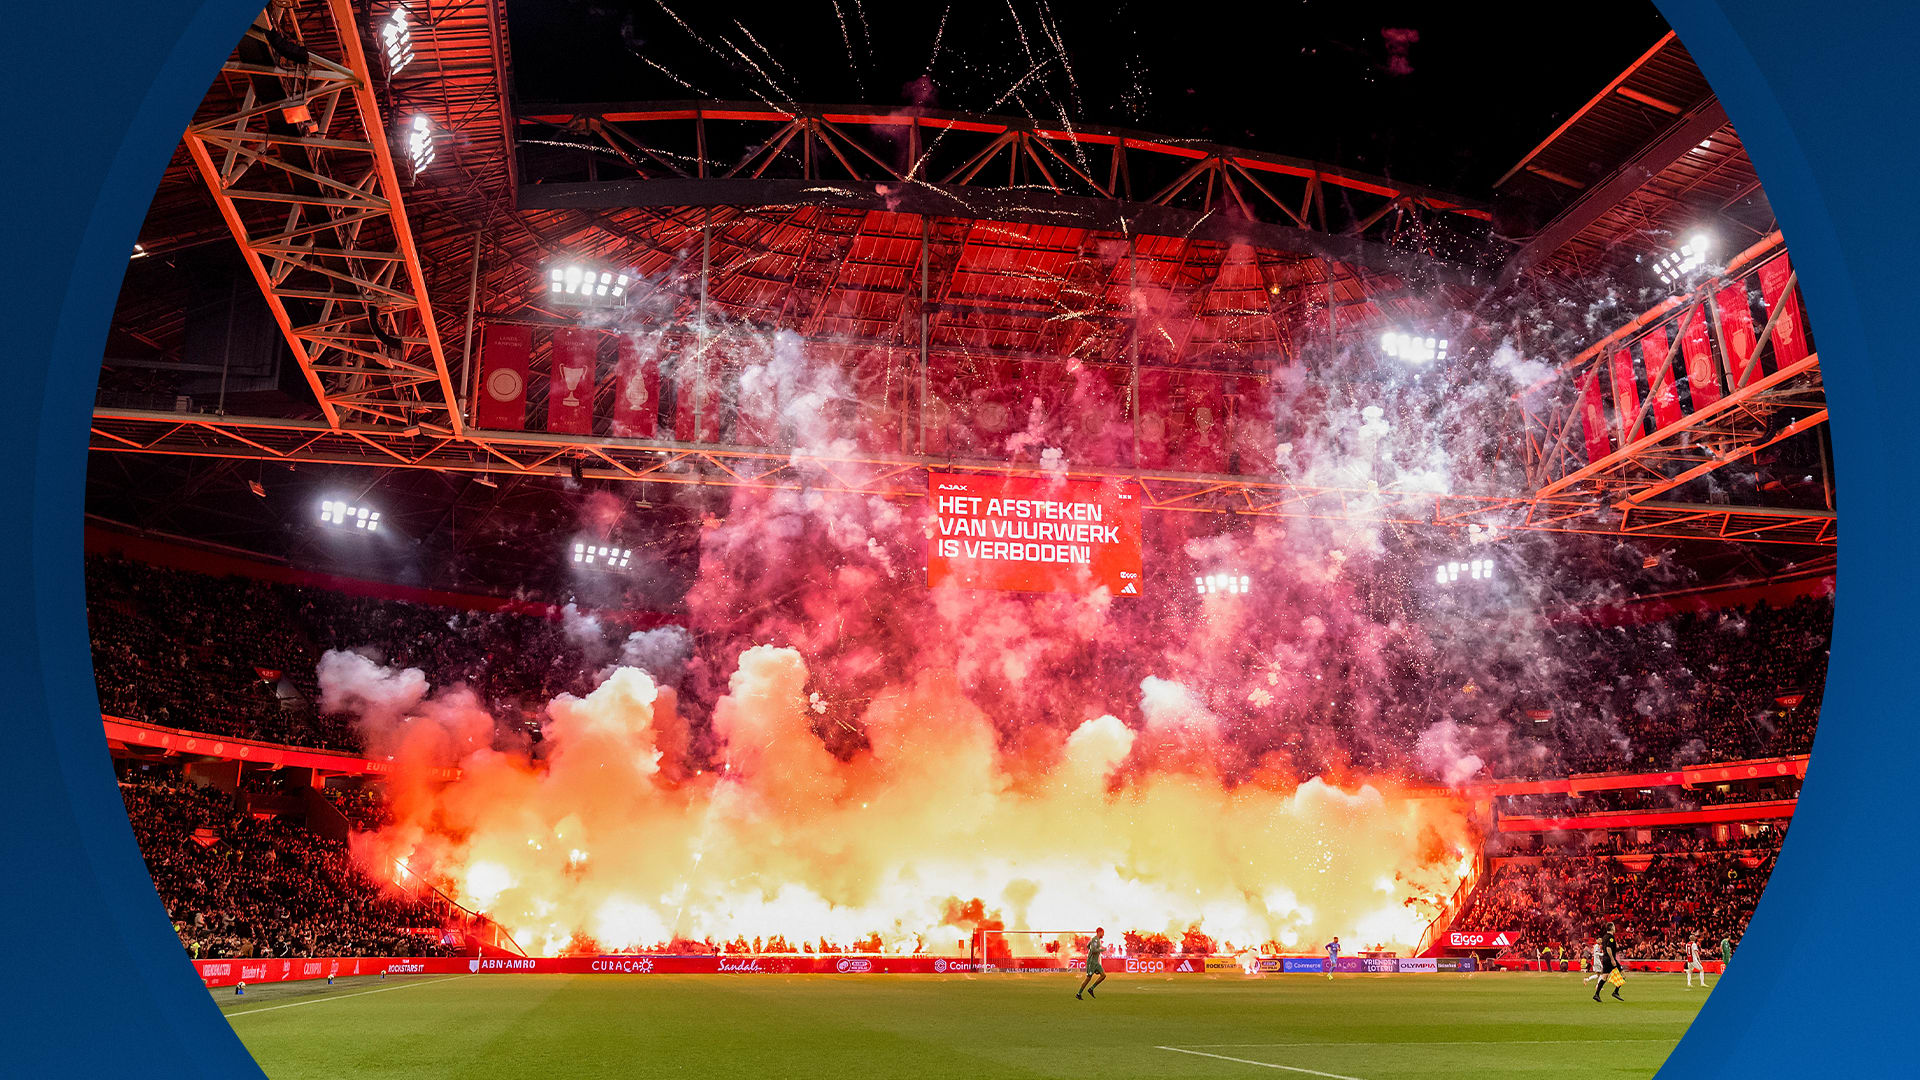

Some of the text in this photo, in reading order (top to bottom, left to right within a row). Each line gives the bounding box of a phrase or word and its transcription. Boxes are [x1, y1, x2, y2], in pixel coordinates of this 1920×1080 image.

[938, 483, 968, 491] AJAX
[938, 495, 1102, 522] HET AFSTEKEN
[938, 517, 1120, 544] VAN VUURWERK
[938, 539, 1091, 564] IS VERBODEN!
[717, 958, 762, 971] Sandals
